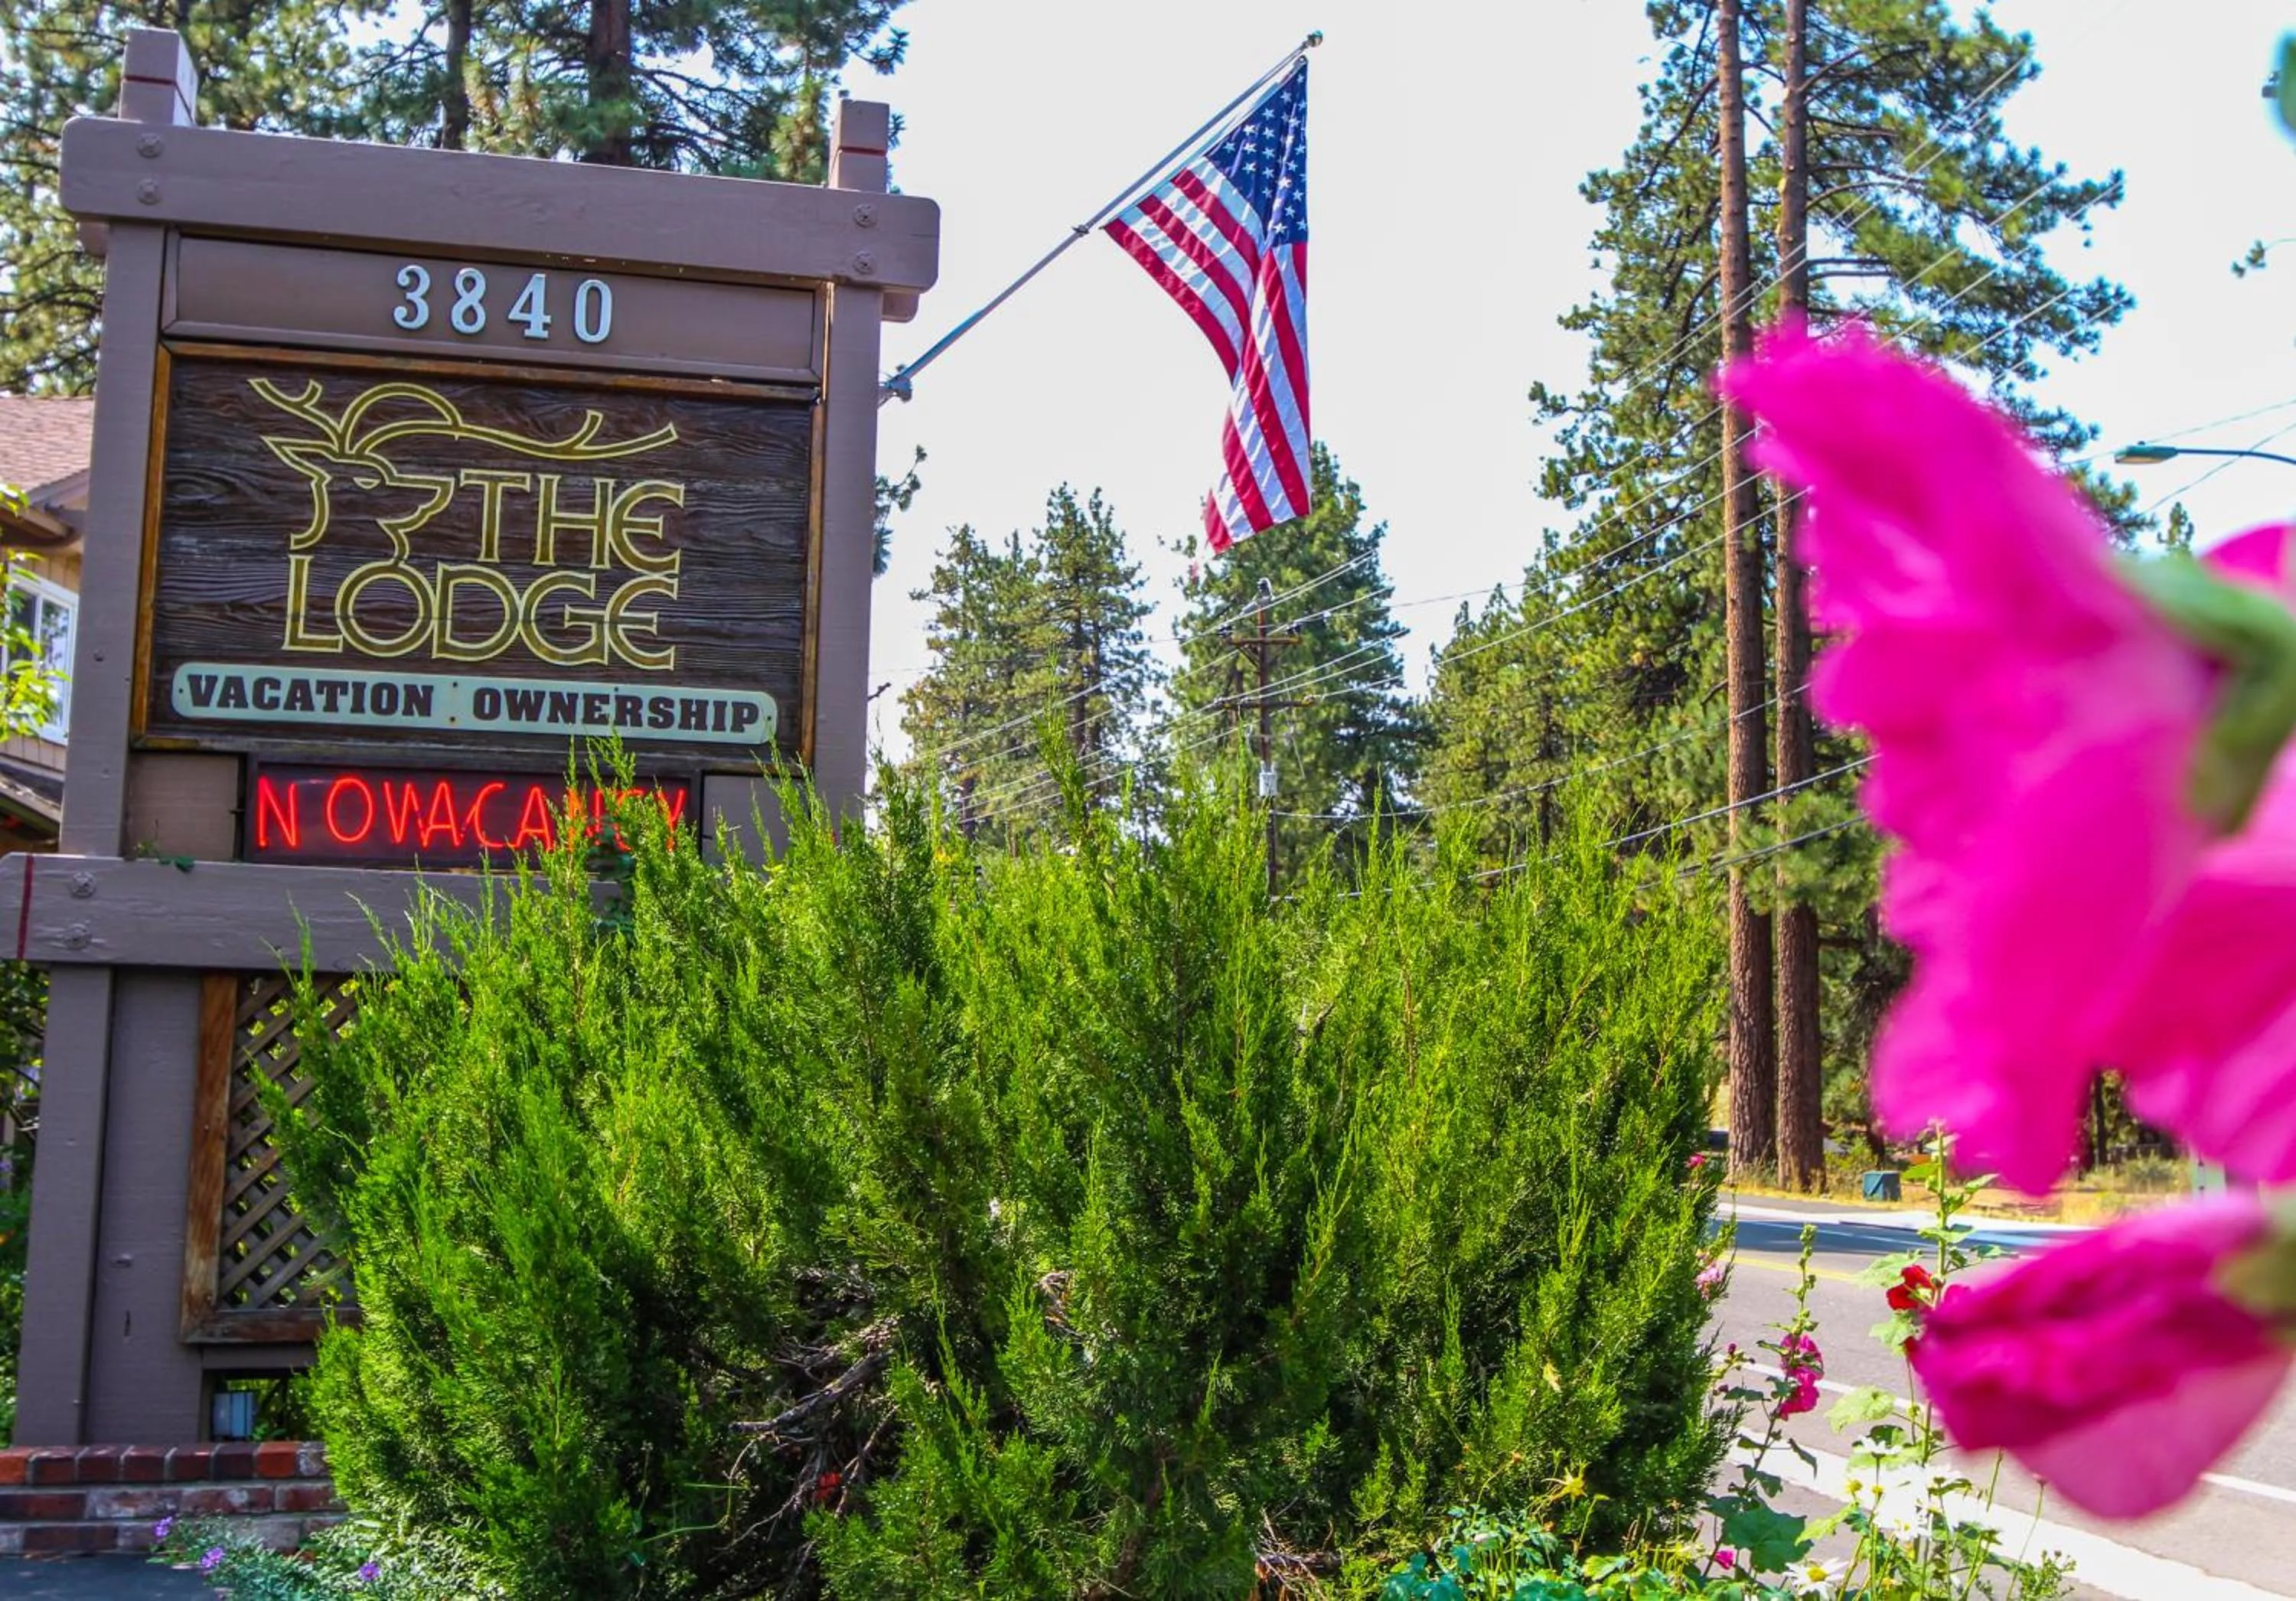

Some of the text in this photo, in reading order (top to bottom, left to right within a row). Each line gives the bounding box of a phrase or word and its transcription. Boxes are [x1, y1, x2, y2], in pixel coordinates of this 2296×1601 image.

[392, 263, 613, 344] 3840
[460, 468, 685, 576] THE
[282, 553, 680, 671] LODGE
[184, 673, 761, 734] VACATION OWNERSHIP
